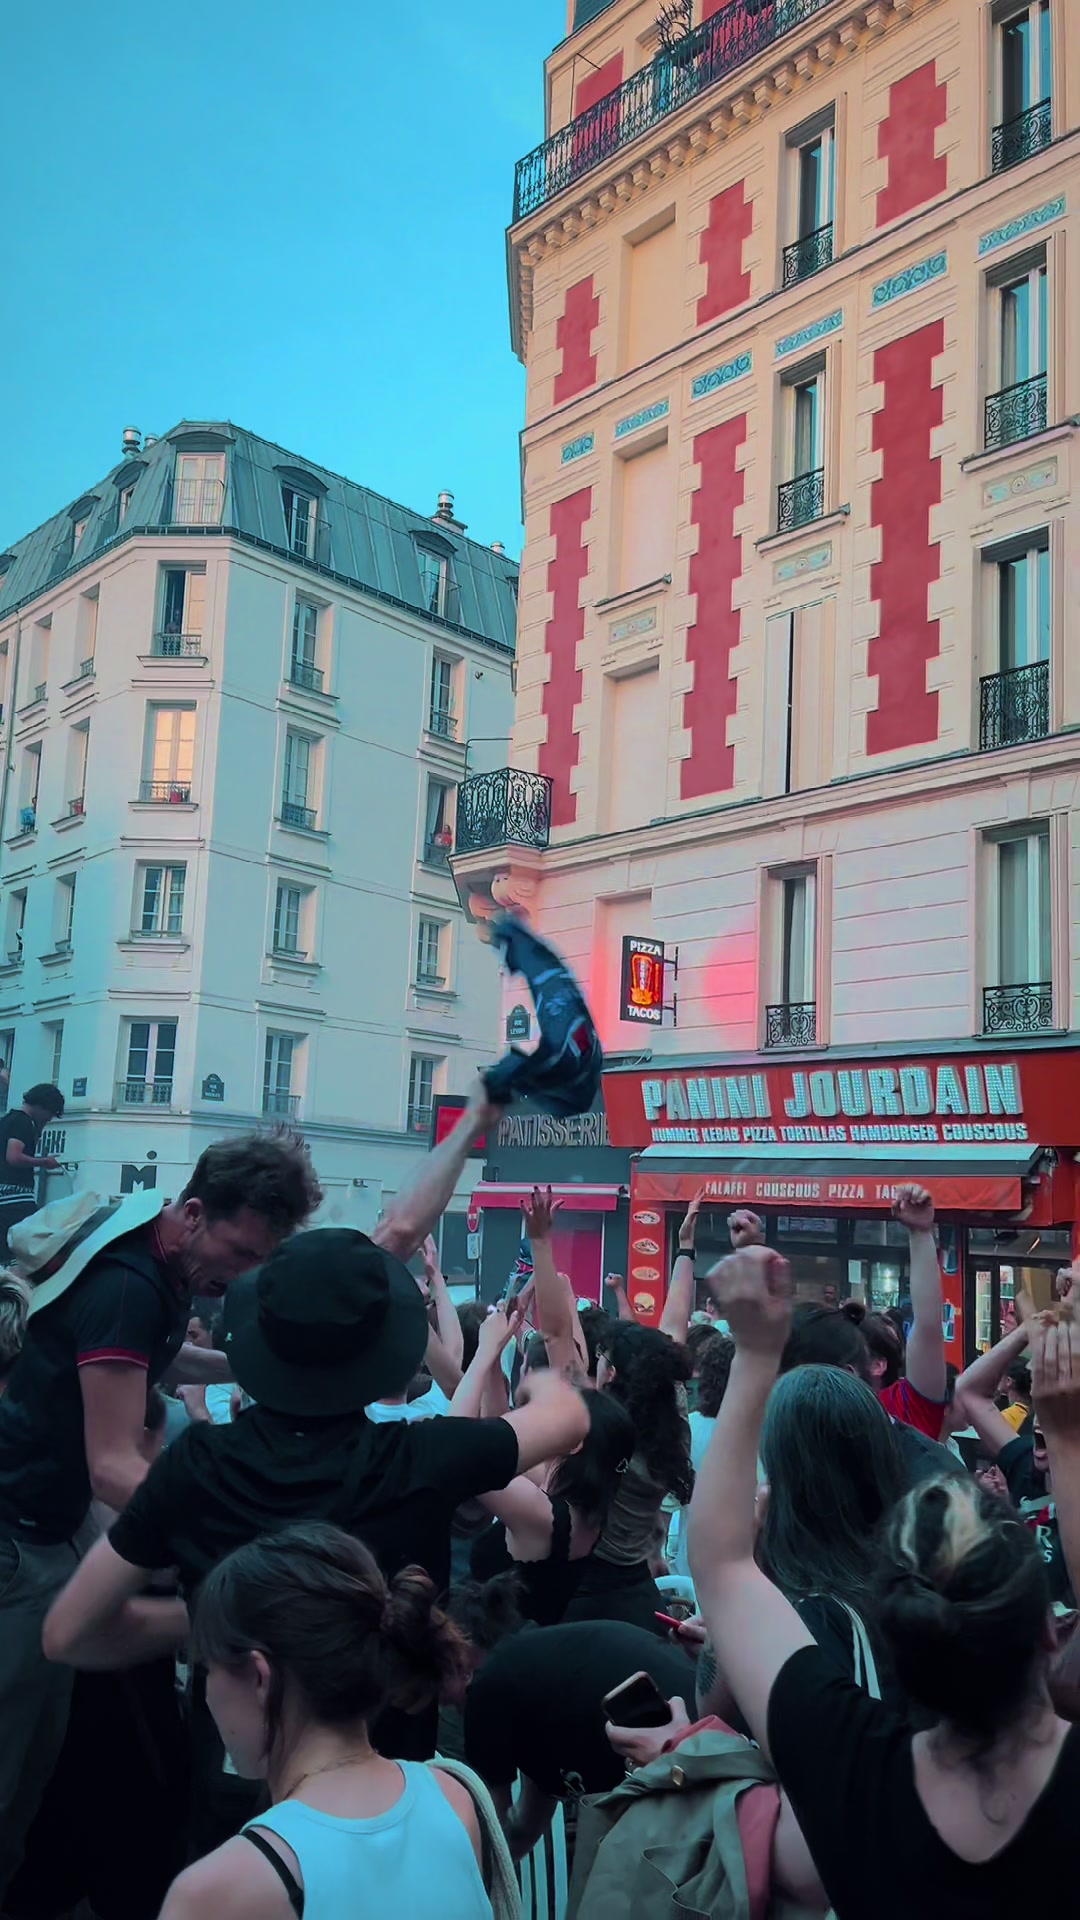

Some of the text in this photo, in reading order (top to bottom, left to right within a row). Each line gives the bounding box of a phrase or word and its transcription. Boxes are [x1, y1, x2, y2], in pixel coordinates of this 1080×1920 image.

[630, 940, 662, 956] PIZZA
[627, 1005, 660, 1020] TACOS
[641, 1063, 1024, 1121] PANINI JOURDAIN
[701, 1127, 740, 1142] KEBAB
[742, 1126, 778, 1142] PIZZA
[779, 1125, 847, 1142] TORTILLAS
[849, 1124, 938, 1142] HAMBURGER
[942, 1123, 1029, 1141] COUSCOUS
[756, 1183, 820, 1199] COUSCOUS
[829, 1184, 865, 1199] PIZZA
[876, 1185, 898, 1200] TAC
